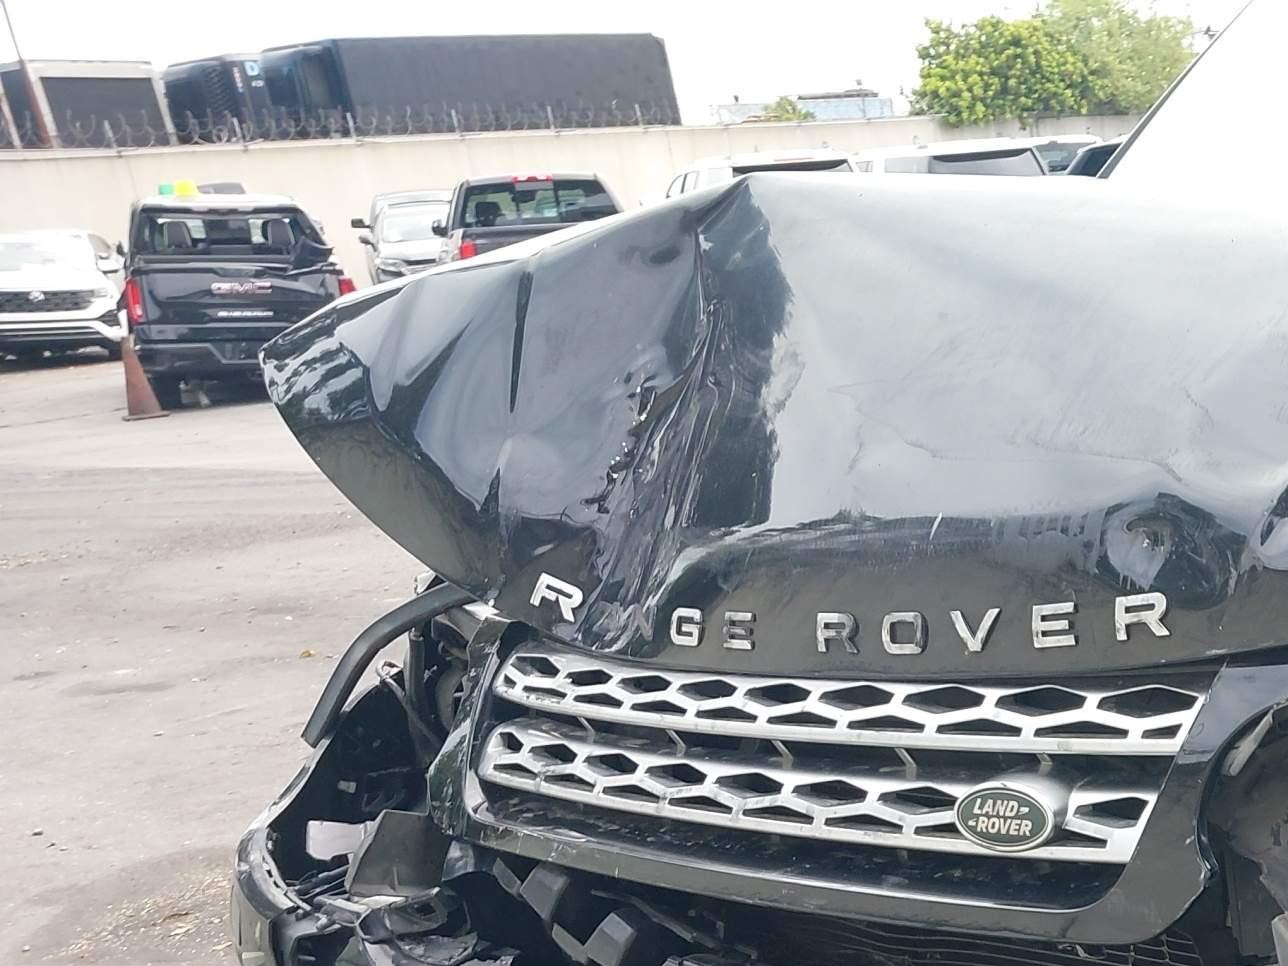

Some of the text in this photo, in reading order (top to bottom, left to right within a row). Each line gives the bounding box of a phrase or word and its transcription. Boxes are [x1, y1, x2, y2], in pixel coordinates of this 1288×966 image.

[210, 282, 273, 294] GMC
[815, 590, 1172, 655] ROVER
[973, 797, 1020, 817] LAND
[976, 816, 1033, 837] ROVER
